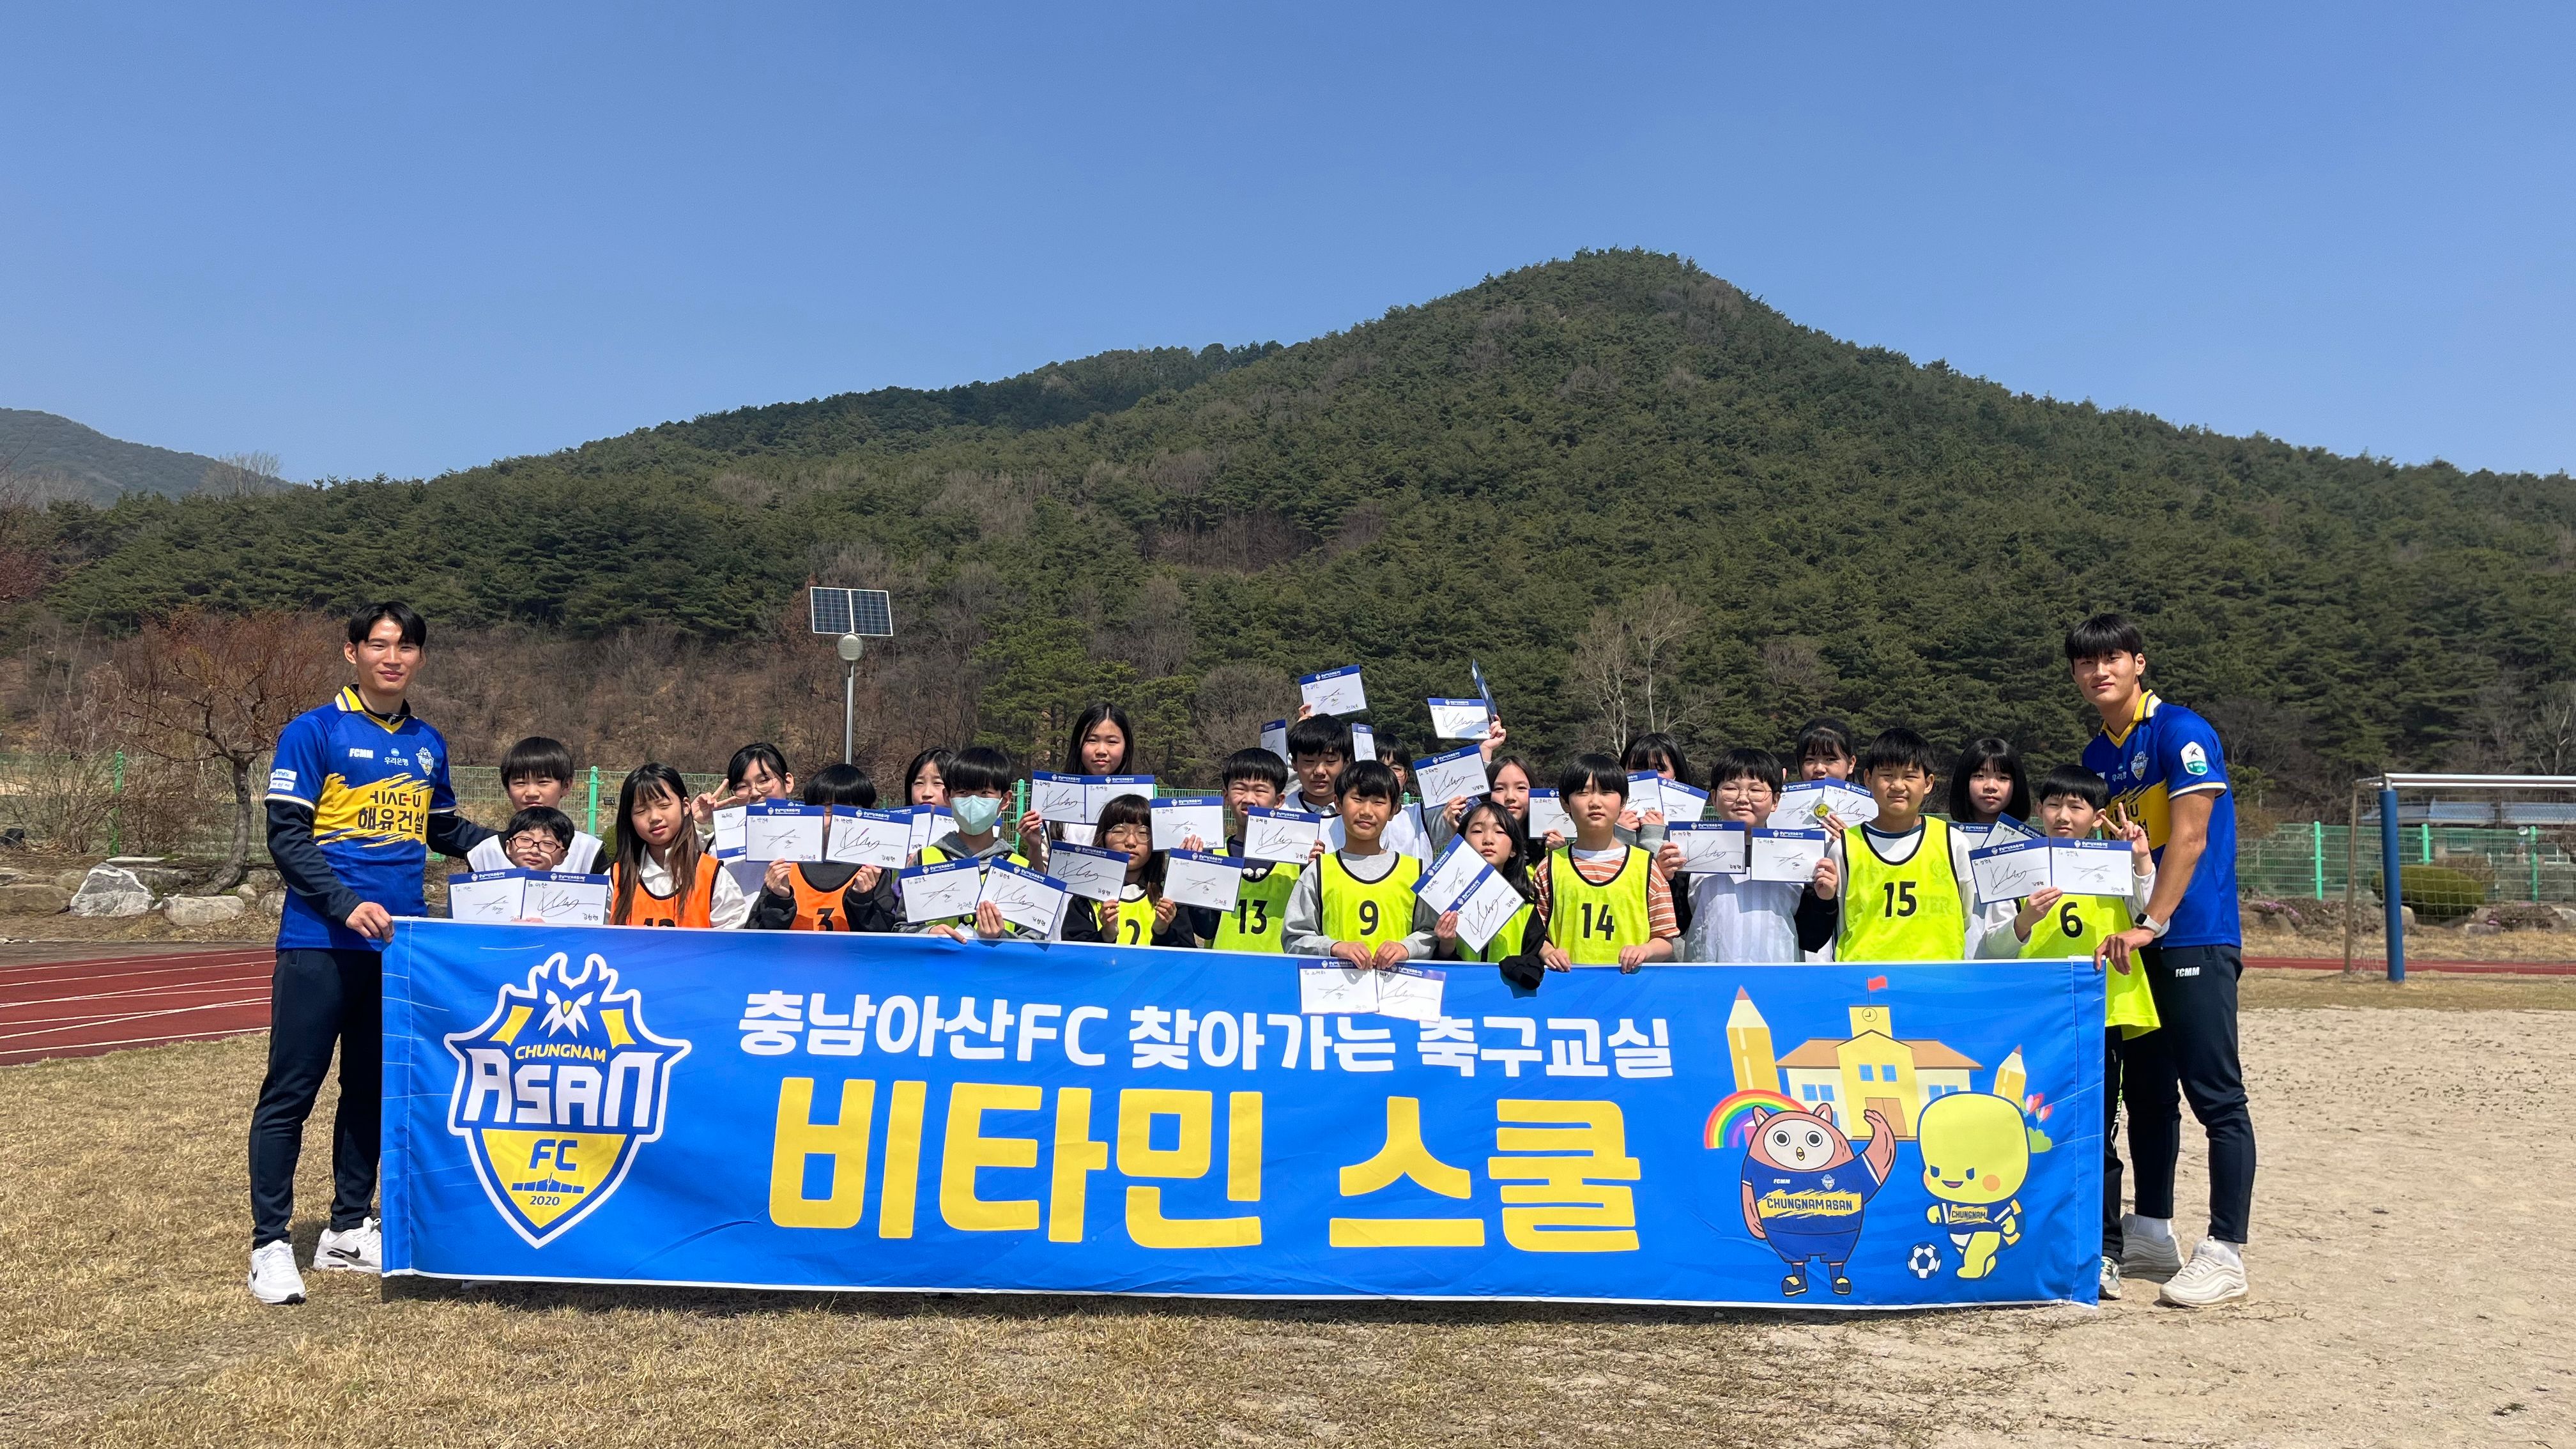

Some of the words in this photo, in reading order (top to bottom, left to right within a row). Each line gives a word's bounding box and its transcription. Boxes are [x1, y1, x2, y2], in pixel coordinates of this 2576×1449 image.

[349, 747, 373, 759] FCMM
[384, 756, 409, 767] 우리은행
[358, 807, 425, 834] 해유건설
[1883, 881, 1917, 917] 15
[816, 907, 834, 931] 3
[1125, 919, 1141, 945] 2
[1238, 899, 1268, 935] 13
[1359, 900, 1379, 936] 9
[1581, 903, 1615, 940] 14
[2060, 901, 2083, 938] 6
[2175, 966, 2200, 977] FCMM
[739, 990, 1108, 1067] 충남아산FC
[1129, 1005, 1396, 1073] 찾아가는
[1416, 1016, 1673, 1078] 축구교실
[515, 1045, 606, 1062] CHUNGNAM
[463, 1048, 664, 1128] ASAN
[528, 1138, 578, 1172] FC
[769, 1077, 1262, 1249] 비타민
[1330, 1096, 1641, 1252] 스쿨
[529, 1195, 560, 1207] 2020
[1951, 1210, 1986, 1219] CHUNGNAM
